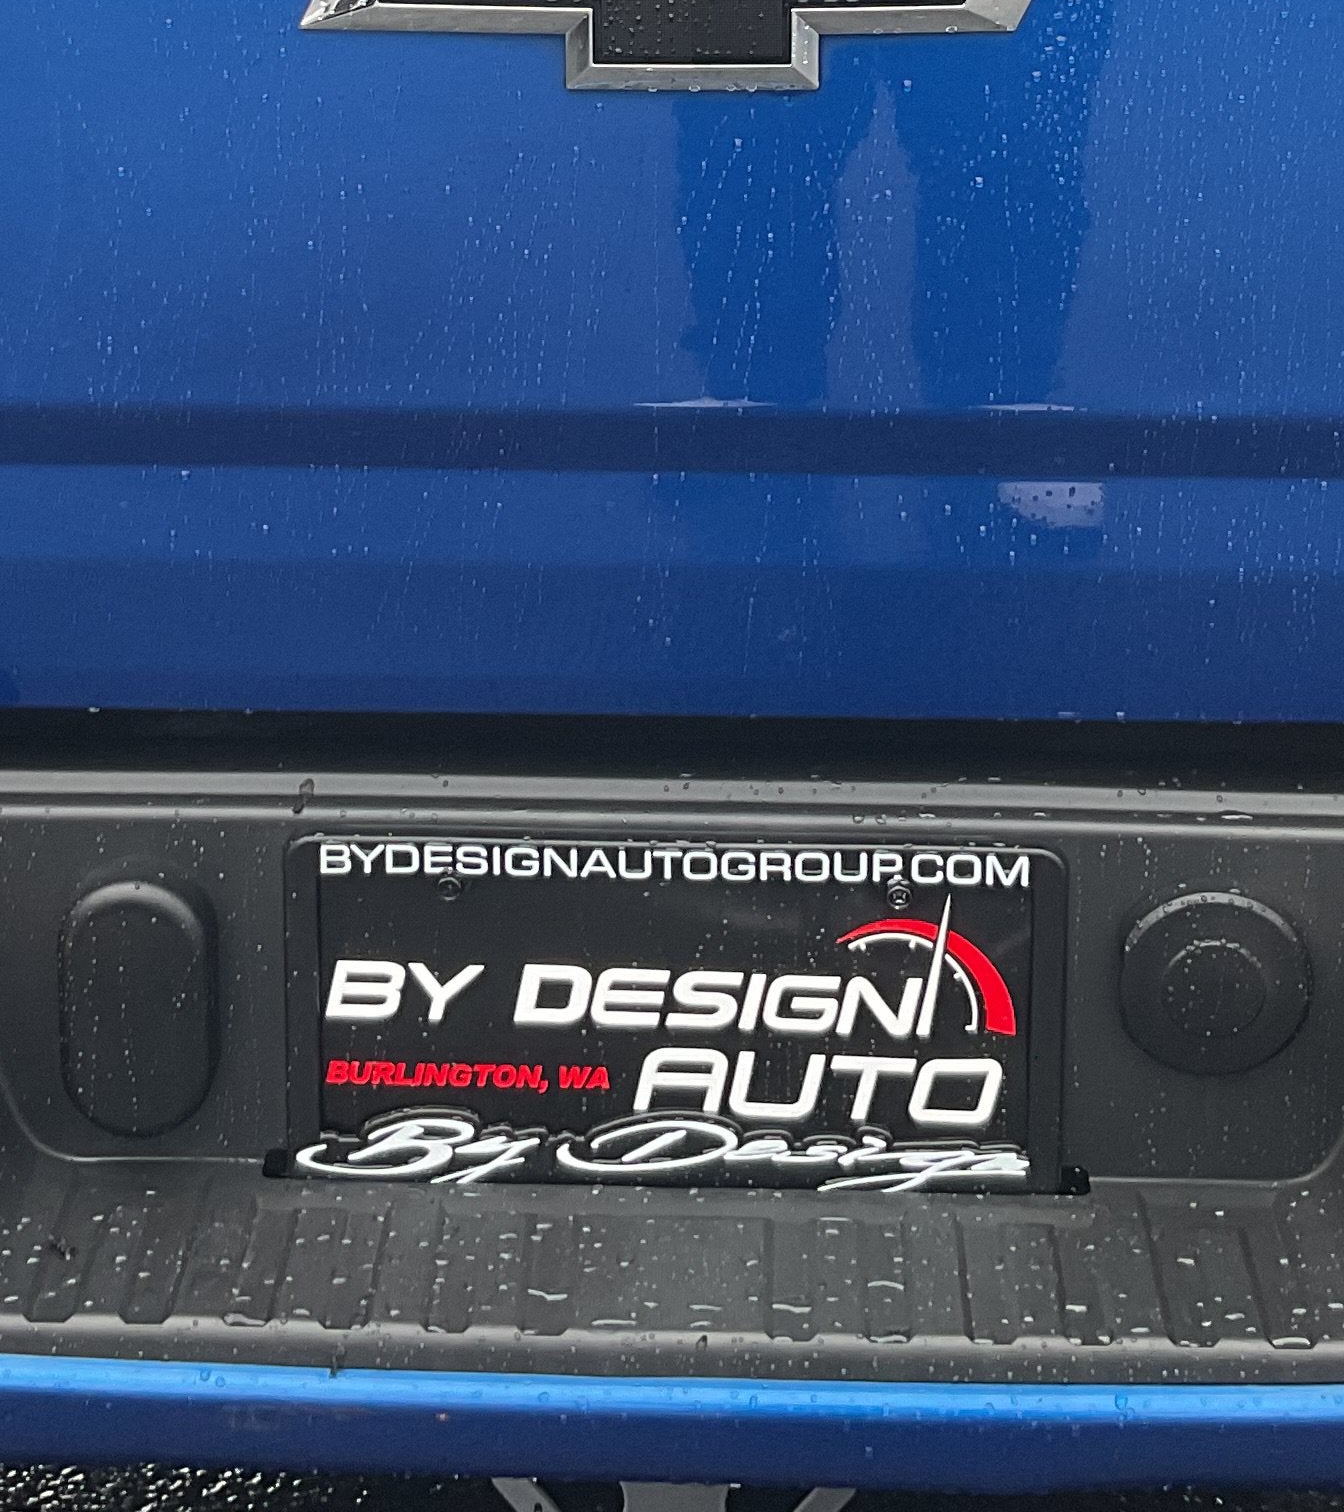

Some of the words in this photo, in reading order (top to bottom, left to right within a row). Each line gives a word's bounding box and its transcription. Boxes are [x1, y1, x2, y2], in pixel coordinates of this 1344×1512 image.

[318, 843, 1032, 888] BYDESIGNAUTOGROUP.COM
[324, 959, 485, 1022] BY
[513, 962, 924, 1037] DESIGN
[325, 1060, 549, 1094] BURLINGTON,
[558, 1065, 611, 1090] WA
[633, 1047, 1005, 1128] AUTO
